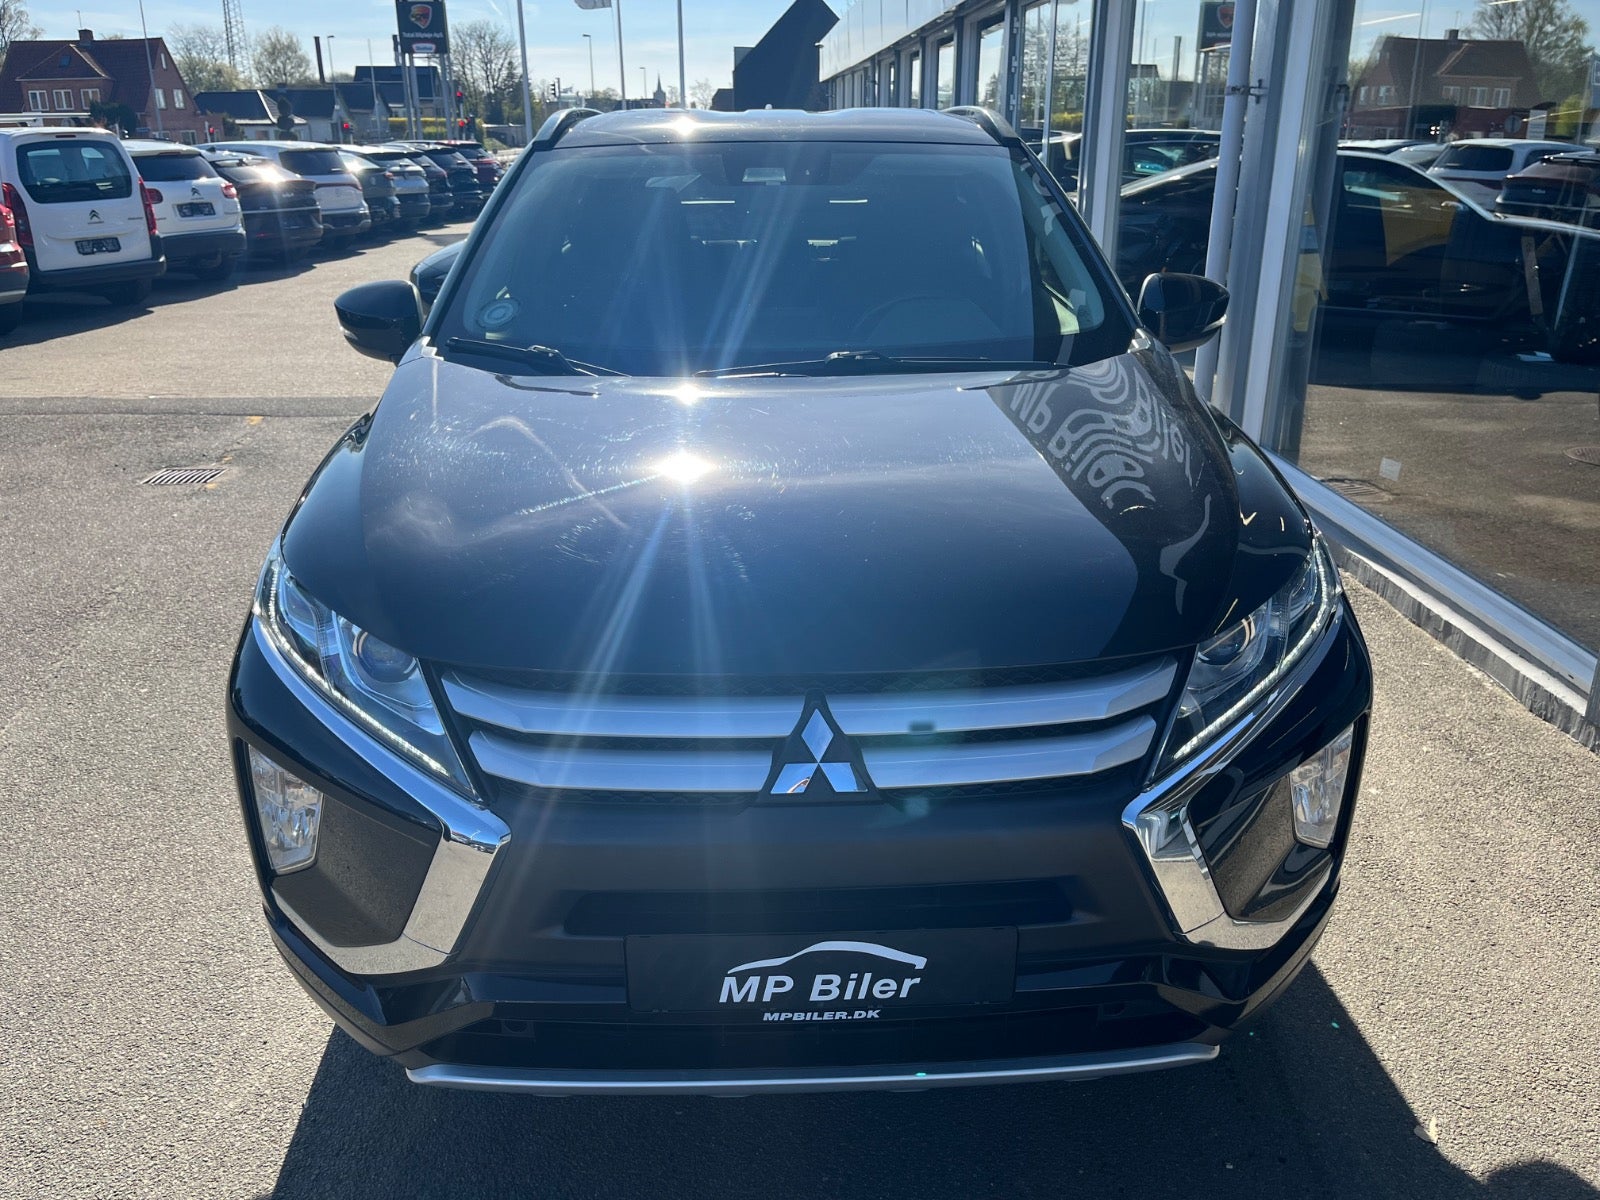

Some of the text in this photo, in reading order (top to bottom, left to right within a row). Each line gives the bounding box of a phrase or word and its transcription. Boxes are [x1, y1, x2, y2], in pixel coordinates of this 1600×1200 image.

[718, 972, 921, 1003] MP Biler
[762, 1009, 881, 1021] MPBILER.DK
